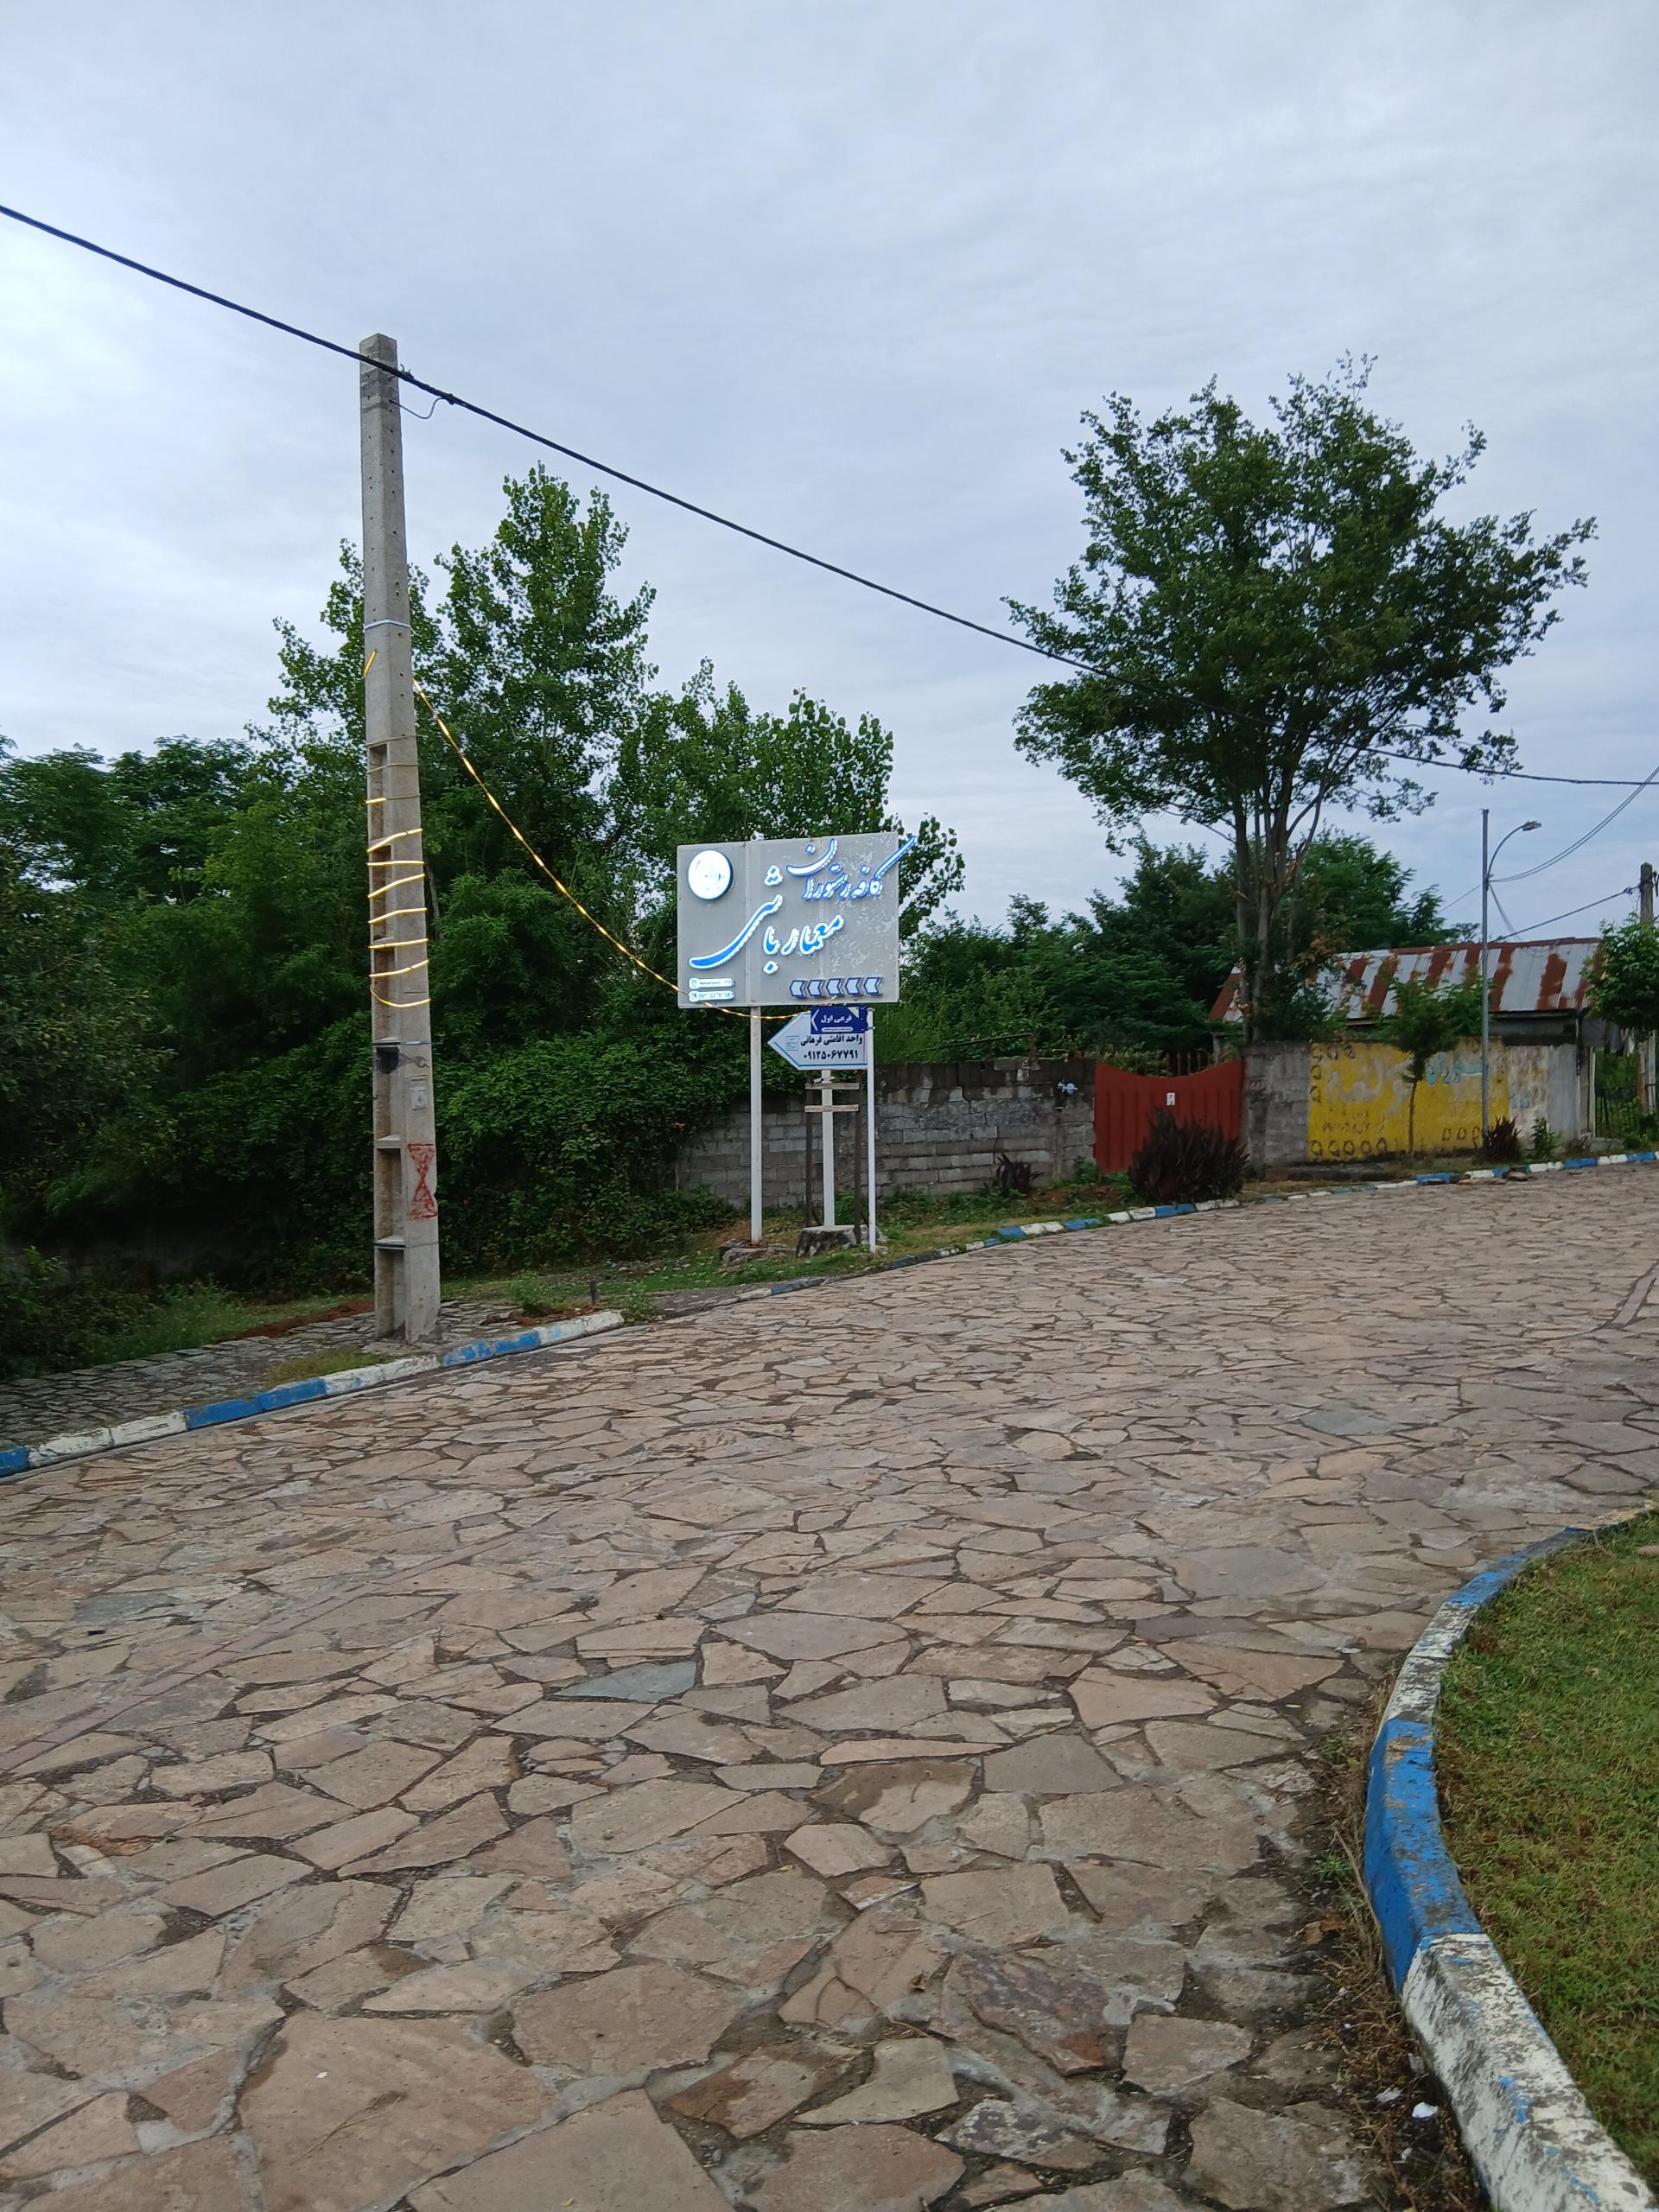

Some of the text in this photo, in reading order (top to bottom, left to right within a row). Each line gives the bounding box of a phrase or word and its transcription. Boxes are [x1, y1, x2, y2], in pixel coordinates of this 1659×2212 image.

[786, 835, 918, 900] کافه رستوران
[820, 1014, 852, 1024] فرعی اول
[845, 1033, 863, 1045] واحد
